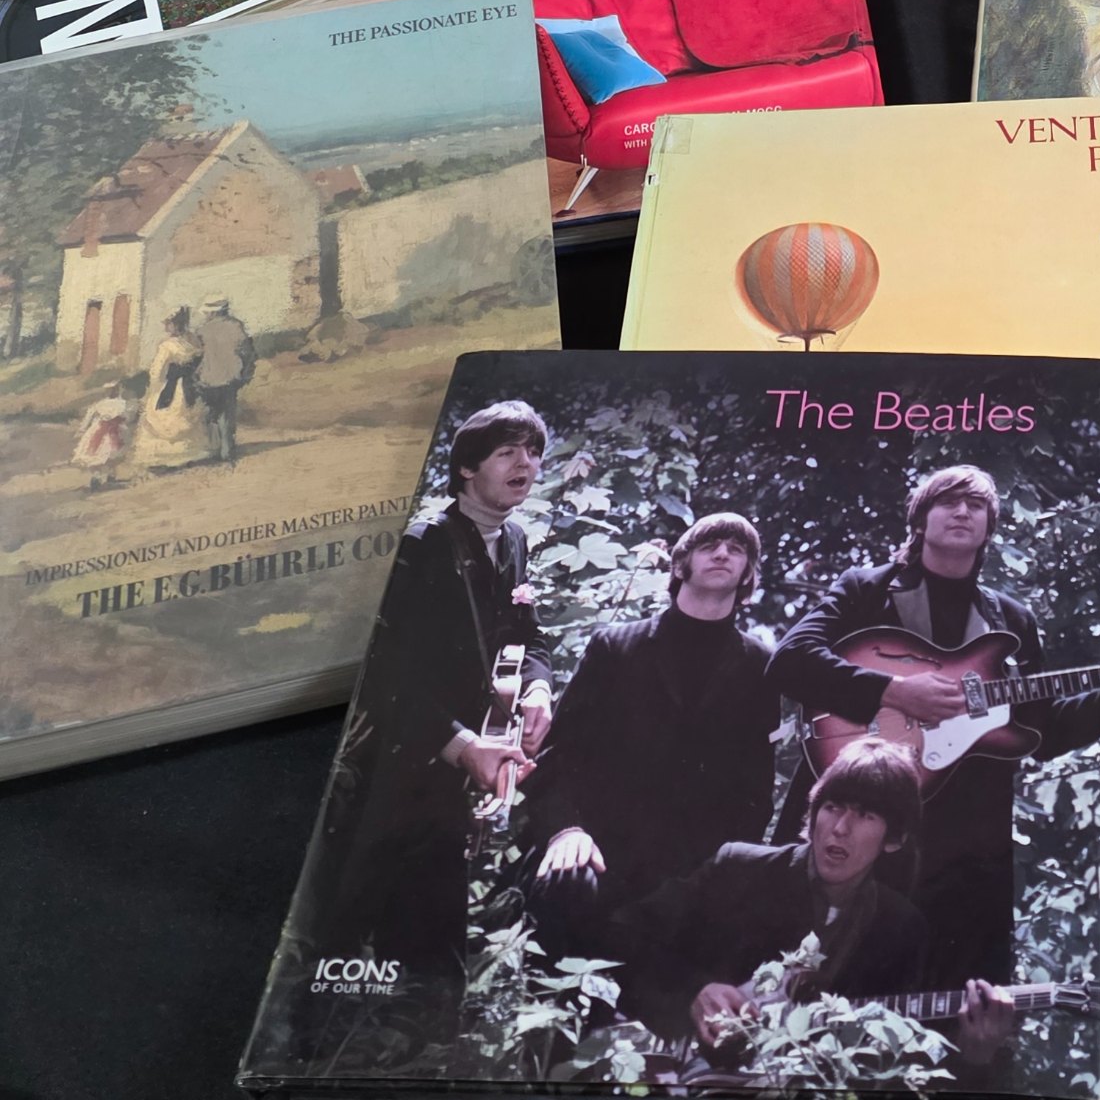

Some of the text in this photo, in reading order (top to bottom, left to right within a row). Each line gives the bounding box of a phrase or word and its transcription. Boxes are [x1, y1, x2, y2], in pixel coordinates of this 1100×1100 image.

[328, 4, 517, 47] THE PASSIONATE EYE
[624, 139, 647, 149] WITH
[766, 389, 1036, 433] The Beatles
[25, 544, 168, 586] IMPRESSIONIST
[171, 535, 211, 557] AND
[215, 522, 277, 548] OTHER
[281, 507, 355, 535] MASTER
[77, 581, 145, 618] THE
[310, 982, 395, 995] OF OUR TIME
[315, 958, 401, 983] ICONS
